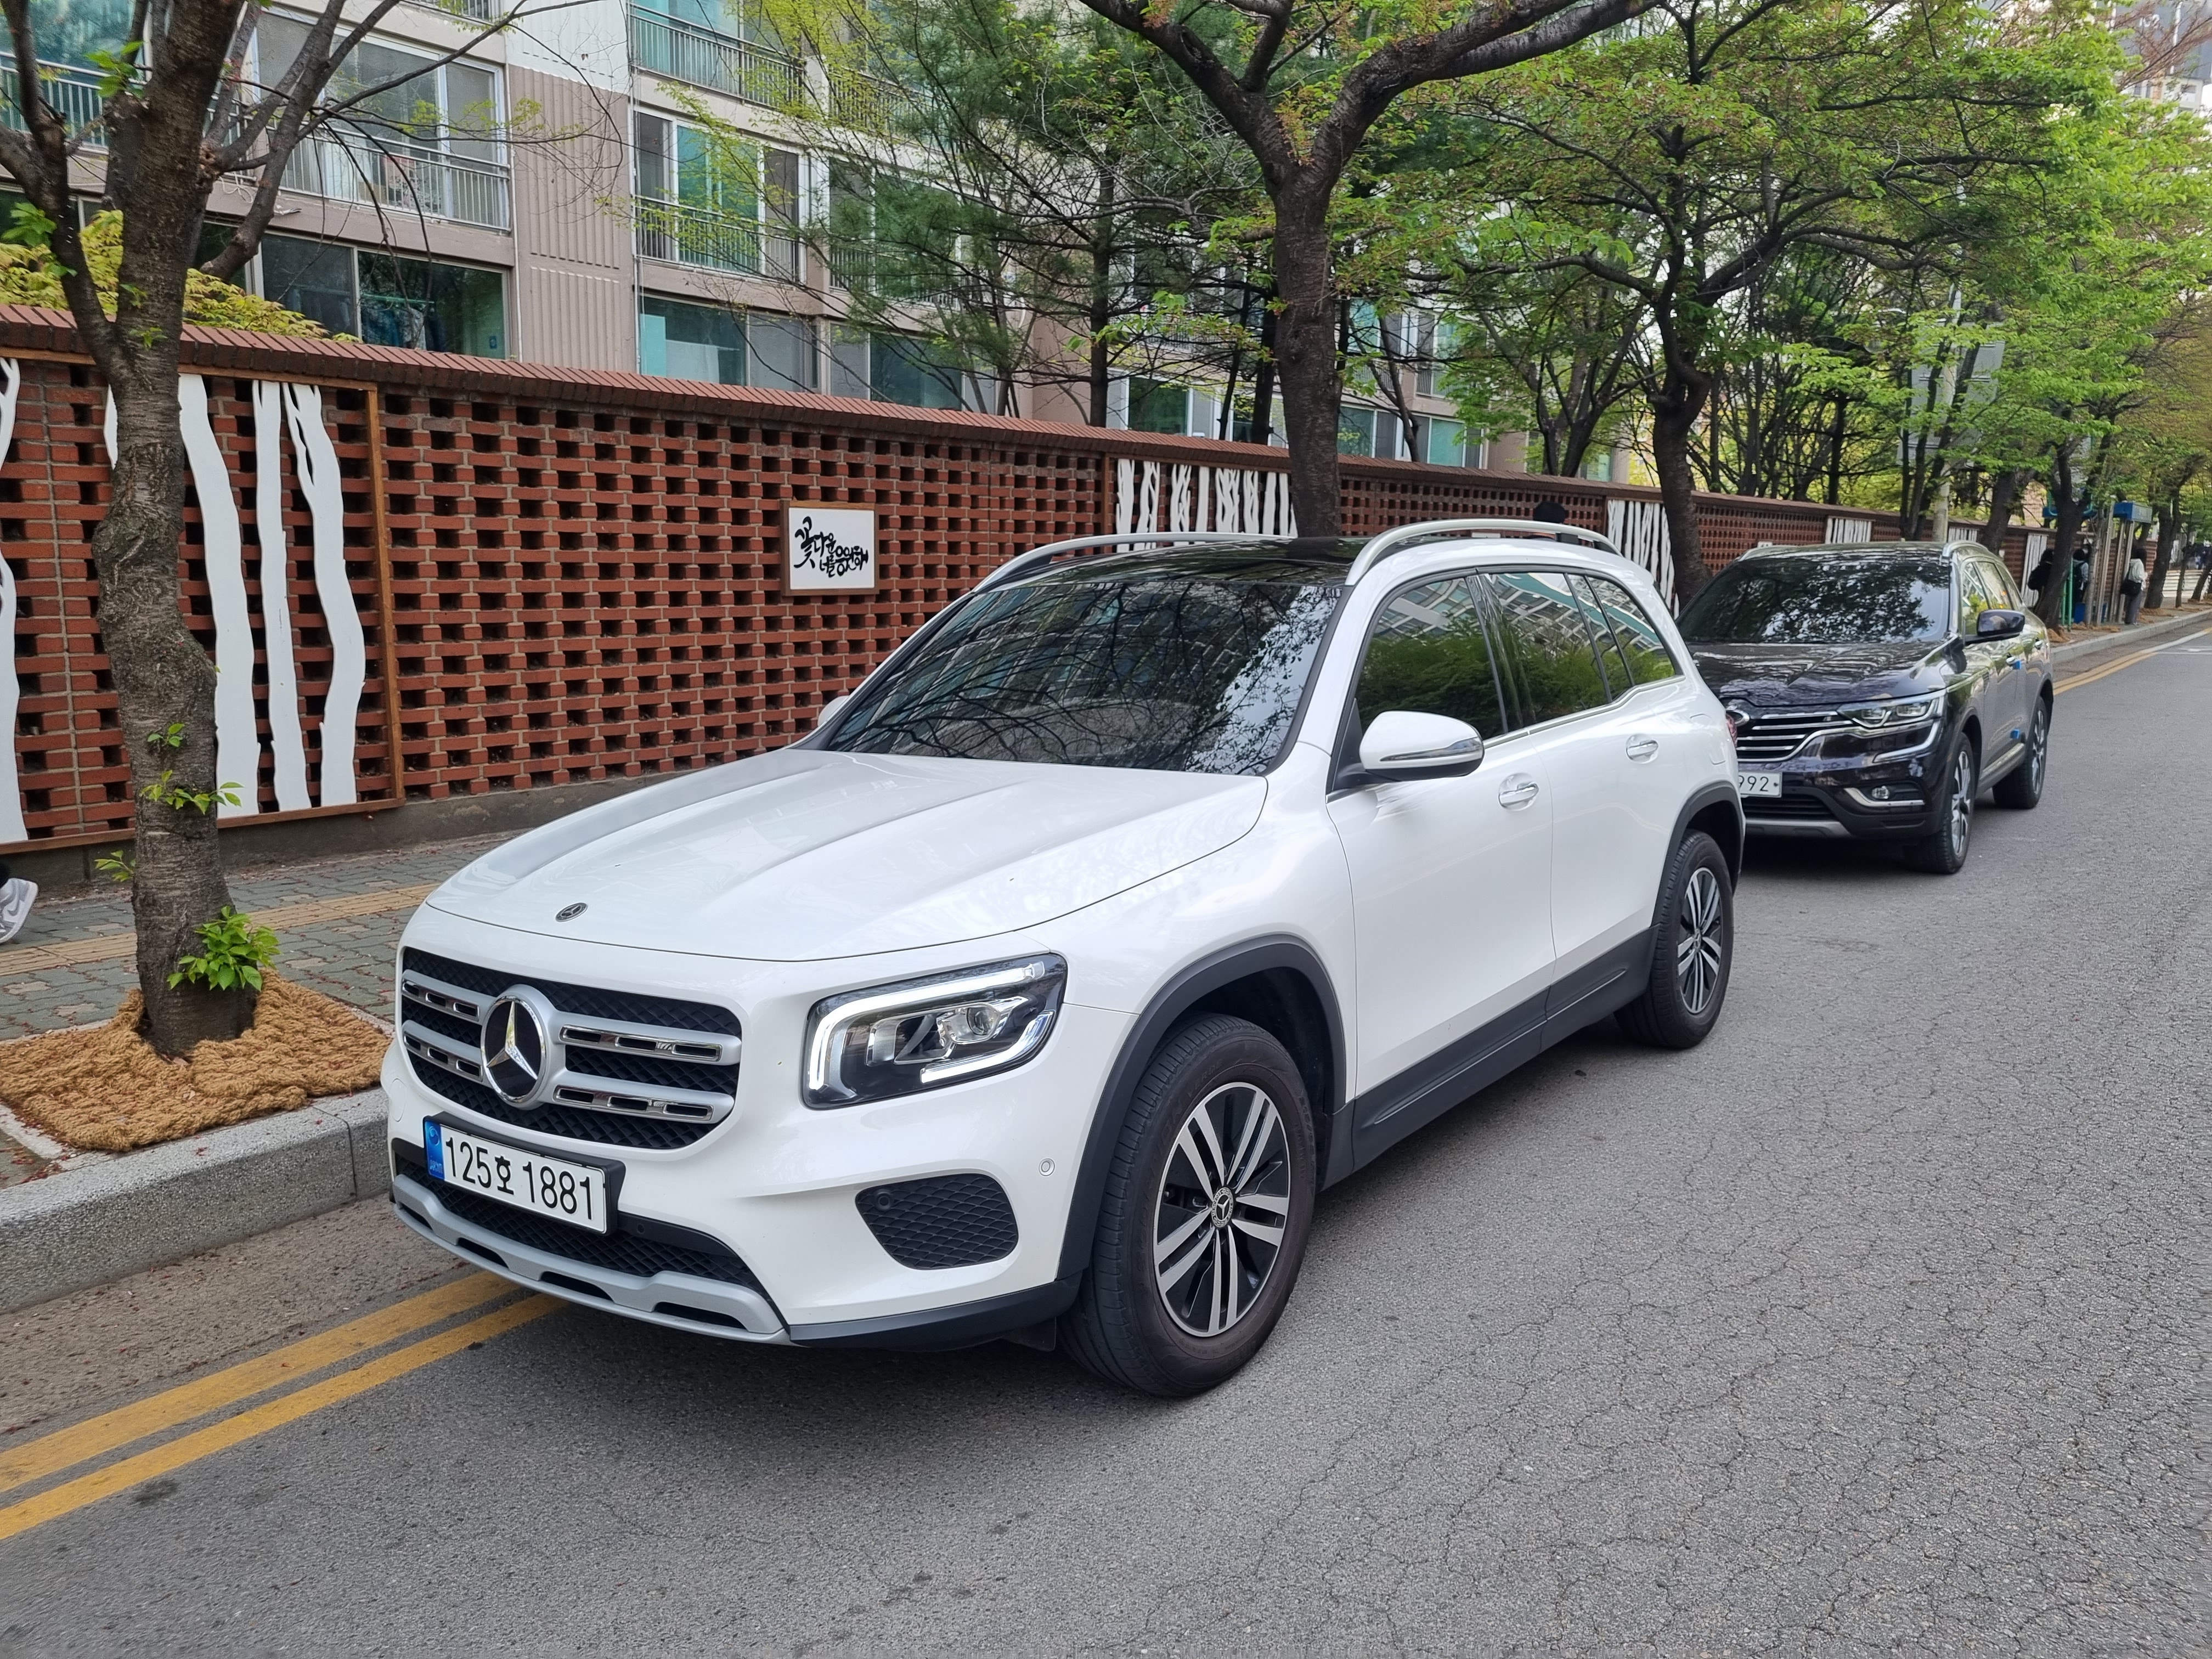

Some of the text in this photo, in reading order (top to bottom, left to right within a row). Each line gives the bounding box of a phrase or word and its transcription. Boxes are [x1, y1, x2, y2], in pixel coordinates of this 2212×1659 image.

[793, 516, 837, 569] 꽃다운
[819, 545, 869, 578] 너를 응원해
[445, 1137, 592, 1220] 125호 1881
